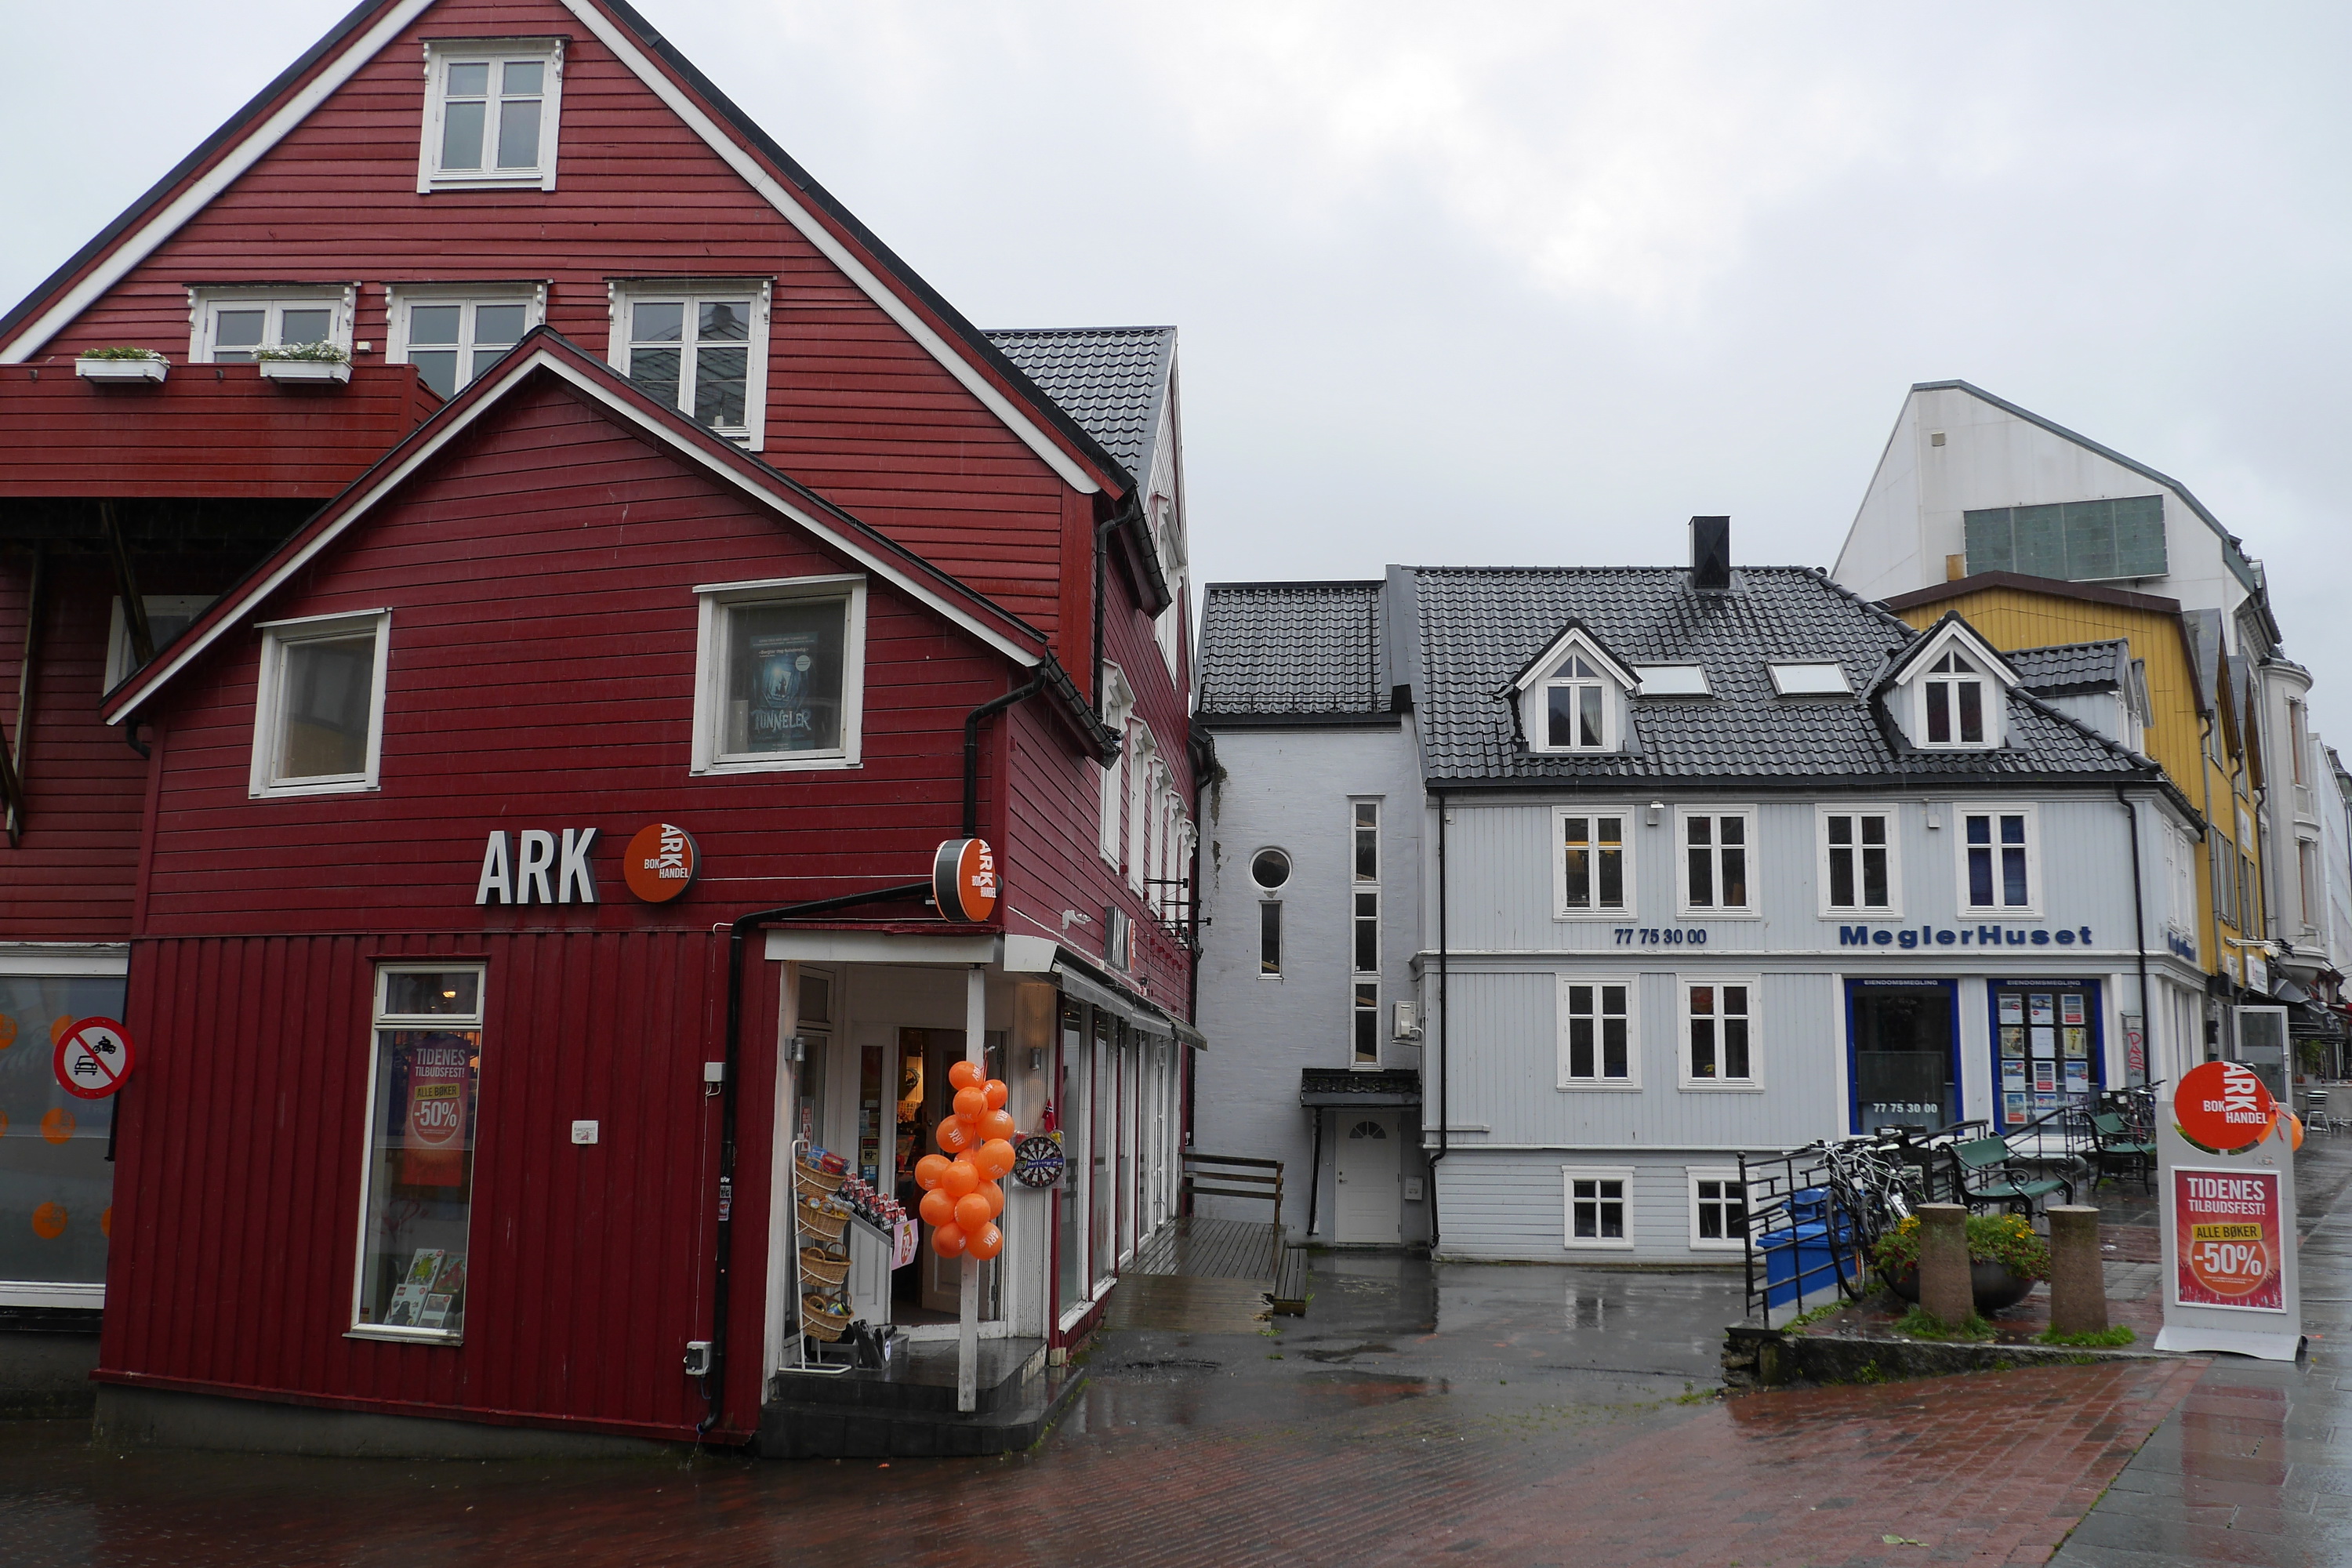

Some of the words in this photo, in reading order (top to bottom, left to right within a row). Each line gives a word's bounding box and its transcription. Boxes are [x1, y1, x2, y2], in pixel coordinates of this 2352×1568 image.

[750, 708, 811, 733] TUNNELER
[660, 823, 684, 869] ARK
[475, 827, 599, 905] ARK
[644, 858, 660, 869] BOK
[978, 839, 993, 887] ARK
[659, 868, 689, 879] HANDEL
[1112, 906, 1126, 969] ARK
[1614, 928, 1634, 944] 77
[1639, 928, 1660, 944] 75
[1663, 928, 1683, 944] 30
[1687, 928, 1707, 944] 00
[1839, 925, 2092, 949] MeglerHuset
[416, 1047, 466, 1066] TIDENES
[415, 1066, 465, 1078] TILBUDSFEST!
[972, 1065, 985, 1083] ARK
[417, 1087, 433, 1098] ALLE
[434, 1085, 457, 1098] BØKER
[982, 1083, 993, 1095] ARK
[2223, 1061, 2257, 1112] ARK
[414, 1101, 457, 1127] -50%
[1873, 1102, 1887, 1113] 77
[1889, 1102, 1904, 1113] 75
[1907, 1102, 1921, 1113] 30
[1924, 1102, 1938, 1113] 00
[2202, 1100, 2227, 1112] BOK
[2226, 1112, 2269, 1124] HANDEL
[948, 1127, 967, 1146] ARK
[2187, 1177, 2266, 1201] TIDENES
[2188, 1199, 2266, 1215] TILBUDSFEST!
[984, 1230, 1000, 1248] ARK
[2197, 1227, 2220, 1238] ALLE
[2223, 1225, 2258, 1240] BØKER
[2194, 1243, 2263, 1276] -50%
